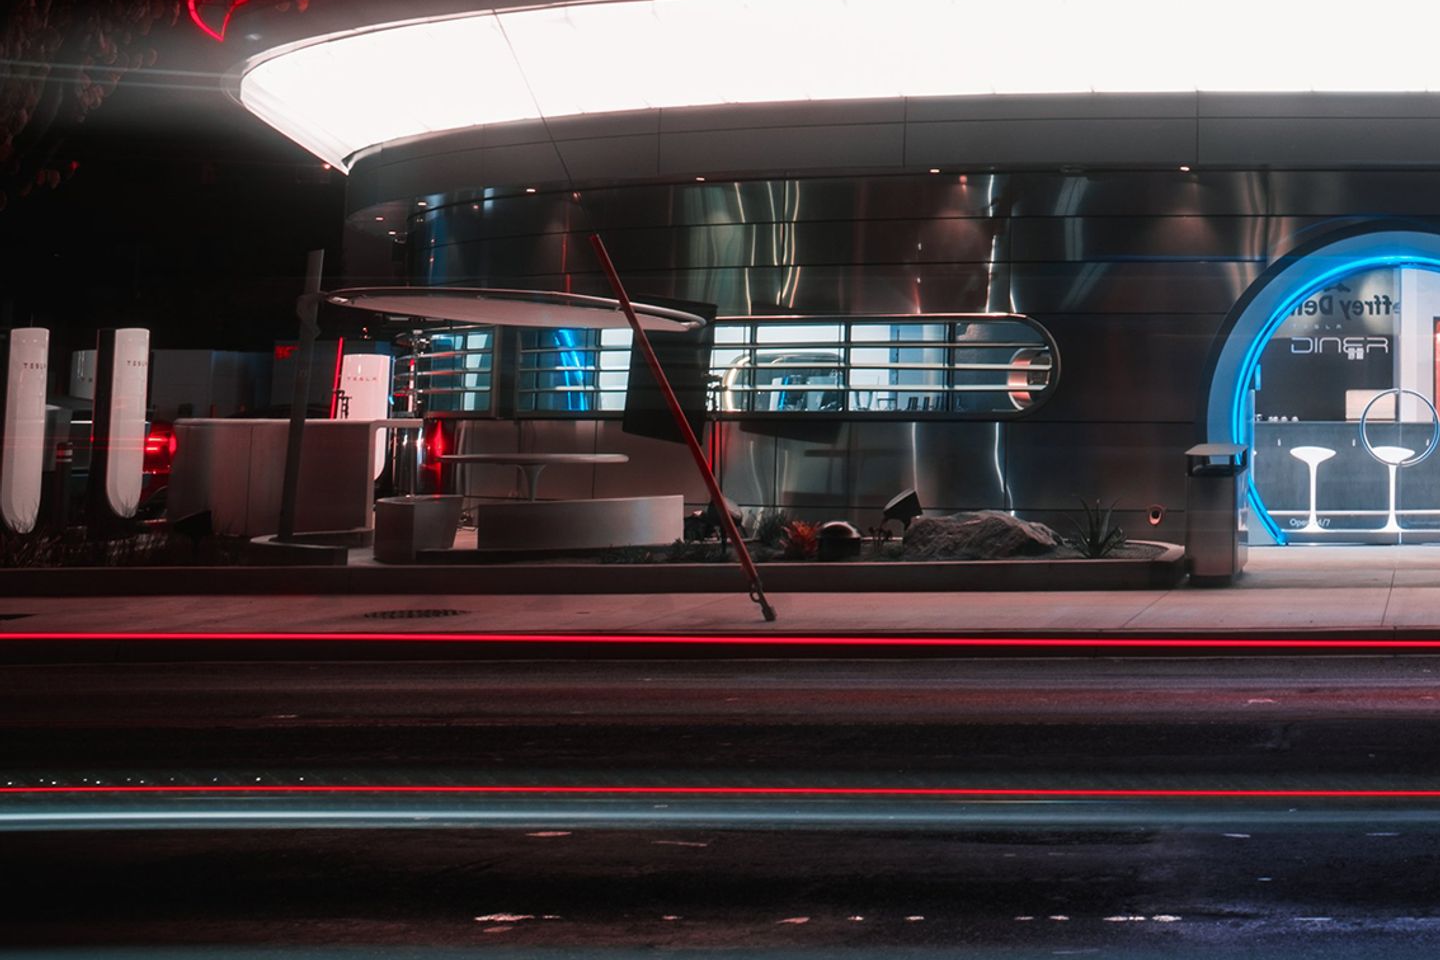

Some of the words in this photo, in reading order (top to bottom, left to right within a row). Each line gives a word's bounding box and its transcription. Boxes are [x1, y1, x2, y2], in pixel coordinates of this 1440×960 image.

[1291, 337, 1389, 354] DINER
[1289, 518, 1309, 528] Ope
[1317, 518, 1331, 527] 4/7
